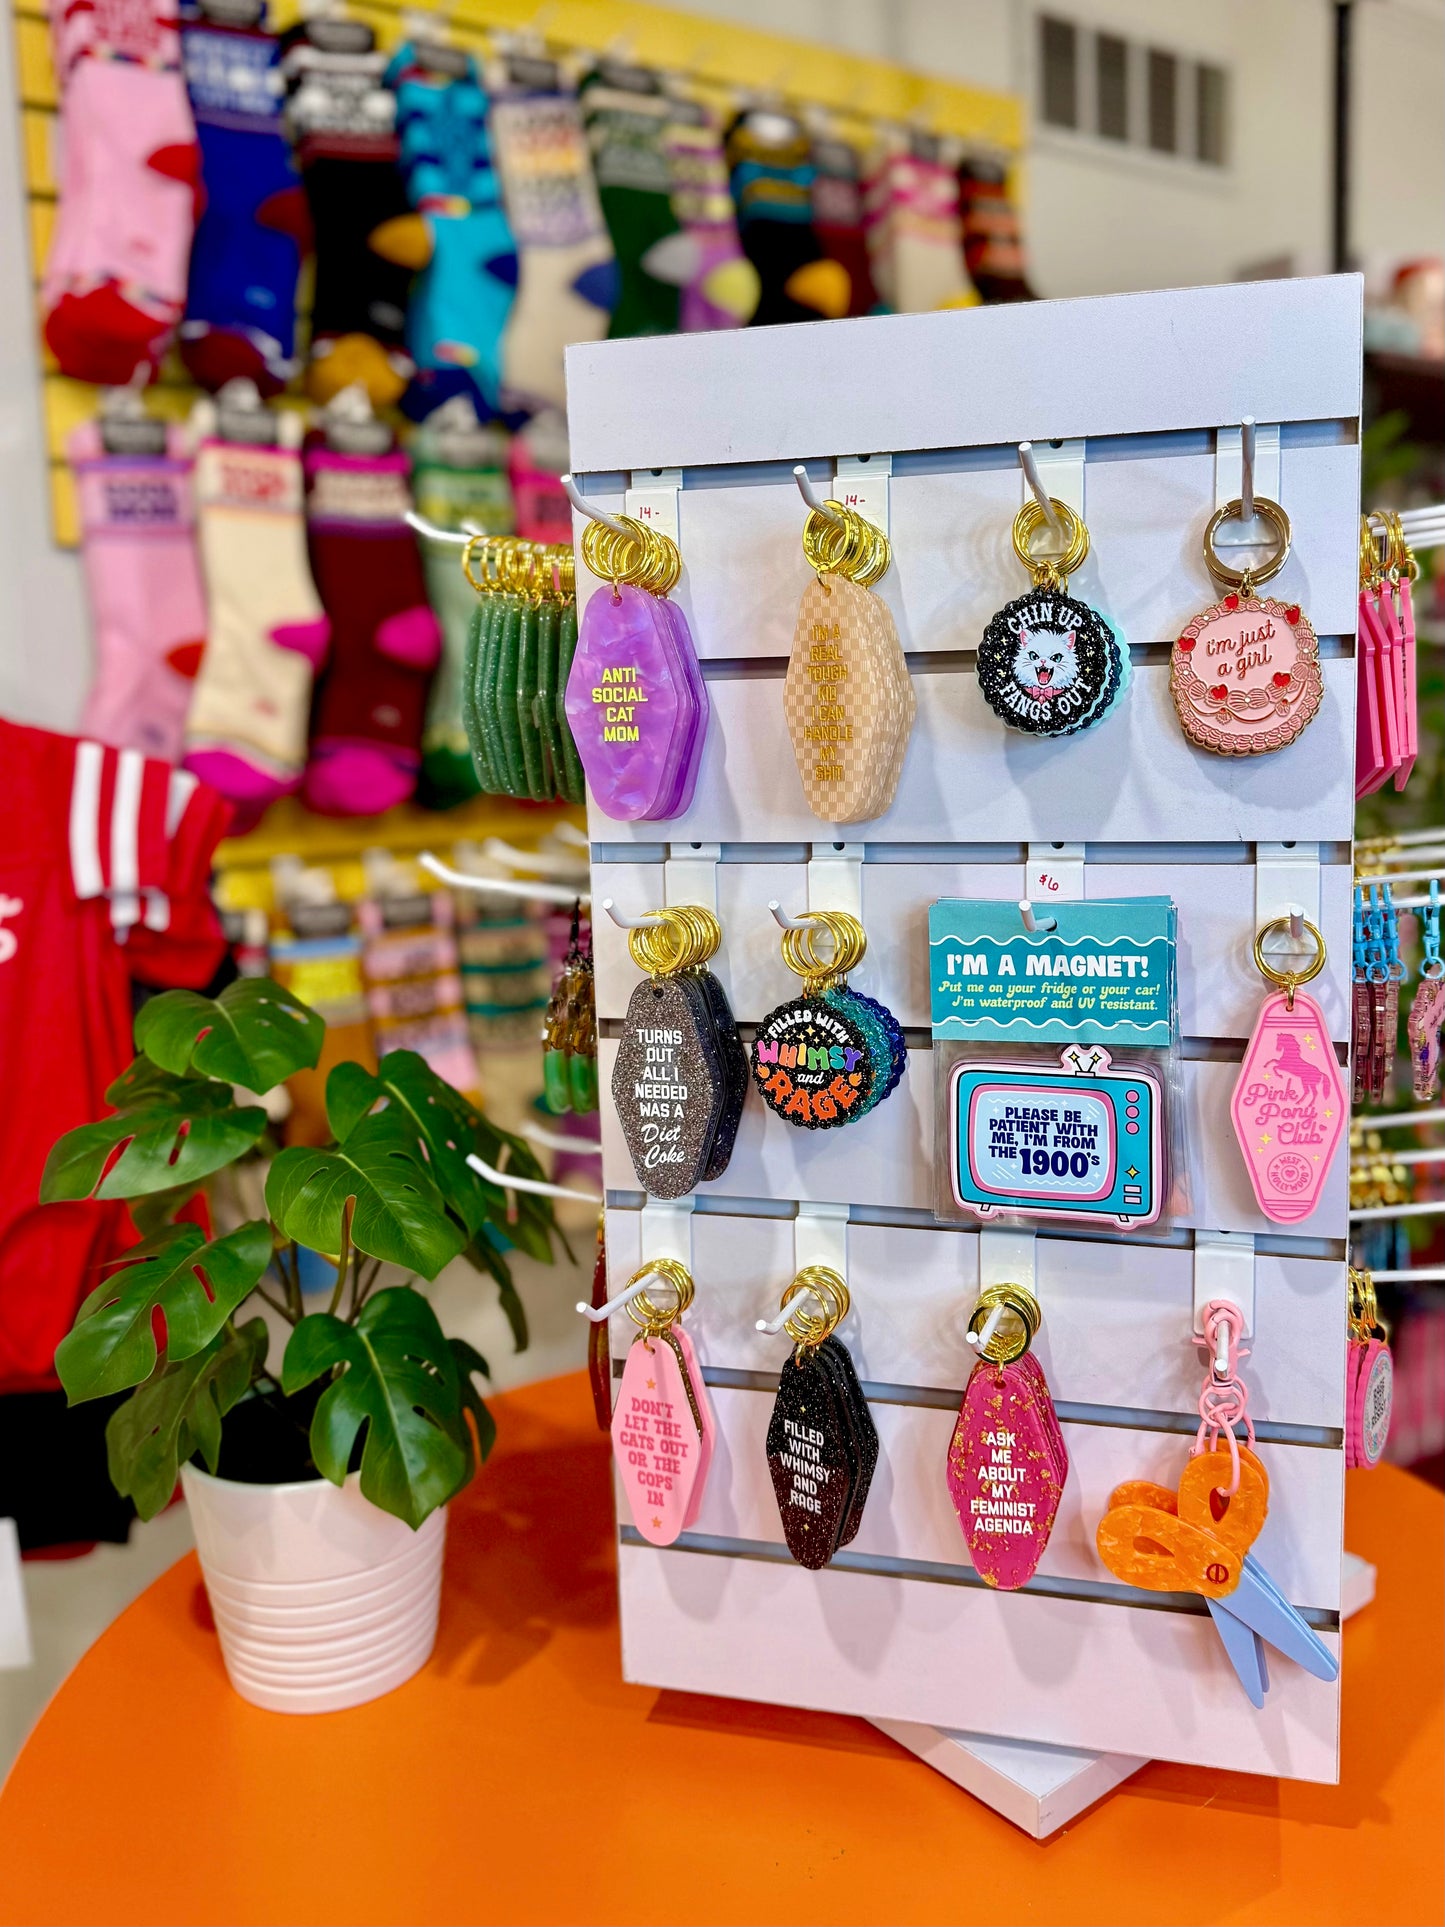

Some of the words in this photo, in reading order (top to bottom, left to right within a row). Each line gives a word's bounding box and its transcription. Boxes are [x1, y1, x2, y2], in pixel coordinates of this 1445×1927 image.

[1007, 602, 1054, 634] CHIN
[1058, 606, 1083, 630] UP
[811, 624, 829, 641] I'M
[832, 624, 842, 641] A
[1206, 639, 1237, 657] i'm
[1235, 619, 1276, 657] just
[810, 645, 844, 661] REAL
[1217, 662, 1233, 677] a
[1236, 643, 1273, 680] girl
[601, 667, 637, 684] ANTI
[806, 665, 849, 681] TOUGH
[592, 687, 648, 703] SOCIAL
[817, 685, 838, 701] KID
[999, 681, 1052, 721] FANGS
[1057, 677, 1092, 715] OUT
[606, 706, 635, 722] CAT
[811, 705, 816, 721] I
[818, 705, 846, 721] CAN
[604, 726, 640, 742] MOM
[803, 725, 854, 741] HANDLE
[819, 746, 837, 761] MY
[815, 765, 844, 781] SHIT
[946, 953, 989, 976] I'M
[997, 954, 1017, 976] A
[1025, 954, 1150, 978] MAGNET!
[938, 980, 963, 993] Put
[966, 983, 985, 993] me
[988, 984, 1004, 993] on
[1005, 983, 1036, 999] your
[1040, 981, 1078, 1000] fridge
[1081, 986, 1097, 995] or
[1098, 985, 1131, 1001] your
[1134, 983, 1161, 996] car!
[979, 996, 1048, 1011] waterproof
[1050, 998, 1074, 1009] and
[1077, 997, 1096, 1009] UV
[1100, 999, 1158, 1011] resistant.
[767, 1009, 812, 1039] FILLED
[815, 1012, 850, 1044] WITH
[635, 1028, 683, 1045] TURNS
[646, 1047, 674, 1063] OUT
[757, 1040, 863, 1072] WHIMSY
[642, 1065, 671, 1081] ALL
[674, 1067, 679, 1082] I
[797, 1072, 825, 1085] and
[634, 1083, 688, 1100] NEEDED
[764, 1069, 859, 1122] RAGE
[1243, 1077, 1299, 1106] Pink
[640, 1101, 670, 1118] WAS
[673, 1103, 684, 1118] A
[1005, 1106, 1059, 1122] PLEASE
[1063, 1110, 1082, 1123] BE
[1255, 1102, 1318, 1130] Pony
[640, 1123, 681, 1144] Diet
[989, 1118, 1050, 1134] PATIENT
[1056, 1122, 1098, 1137] WITH
[1277, 1121, 1324, 1146] Club
[991, 1131, 1019, 1147] ME,
[1024, 1133, 1048, 1147] I'M
[1053, 1135, 1096, 1150] FROM
[644, 1144, 686, 1169] Coke
[988, 1145, 1017, 1159] THE
[1019, 1148, 1101, 1179] 1900's
[1279, 1155, 1302, 1166] WEST
[1271, 1171, 1310, 1192] HOLLYWOOD
[631, 1397, 674, 1420] DON'T
[625, 1414, 649, 1432] LET
[654, 1419, 682, 1438] THE
[784, 1419, 824, 1447] FILLED
[620, 1431, 655, 1451] CATS
[660, 1439, 689, 1458] OUT
[986, 1431, 1016, 1447] ASK
[789, 1437, 820, 1463] WITH
[991, 1448, 1012, 1464] ME
[628, 1450, 648, 1468] OR
[653, 1455, 681, 1475] THE
[780, 1450, 830, 1484] WHIMSY
[637, 1470, 673, 1491] COPS
[978, 1465, 1026, 1482] ABOUT
[793, 1473, 818, 1496] AND
[991, 1483, 1013, 1499] MY
[647, 1490, 665, 1507] IN
[790, 1488, 822, 1515] RAGE
[970, 1499, 1036, 1518] FEMINIST
[974, 1517, 1034, 1535] AGENDA
